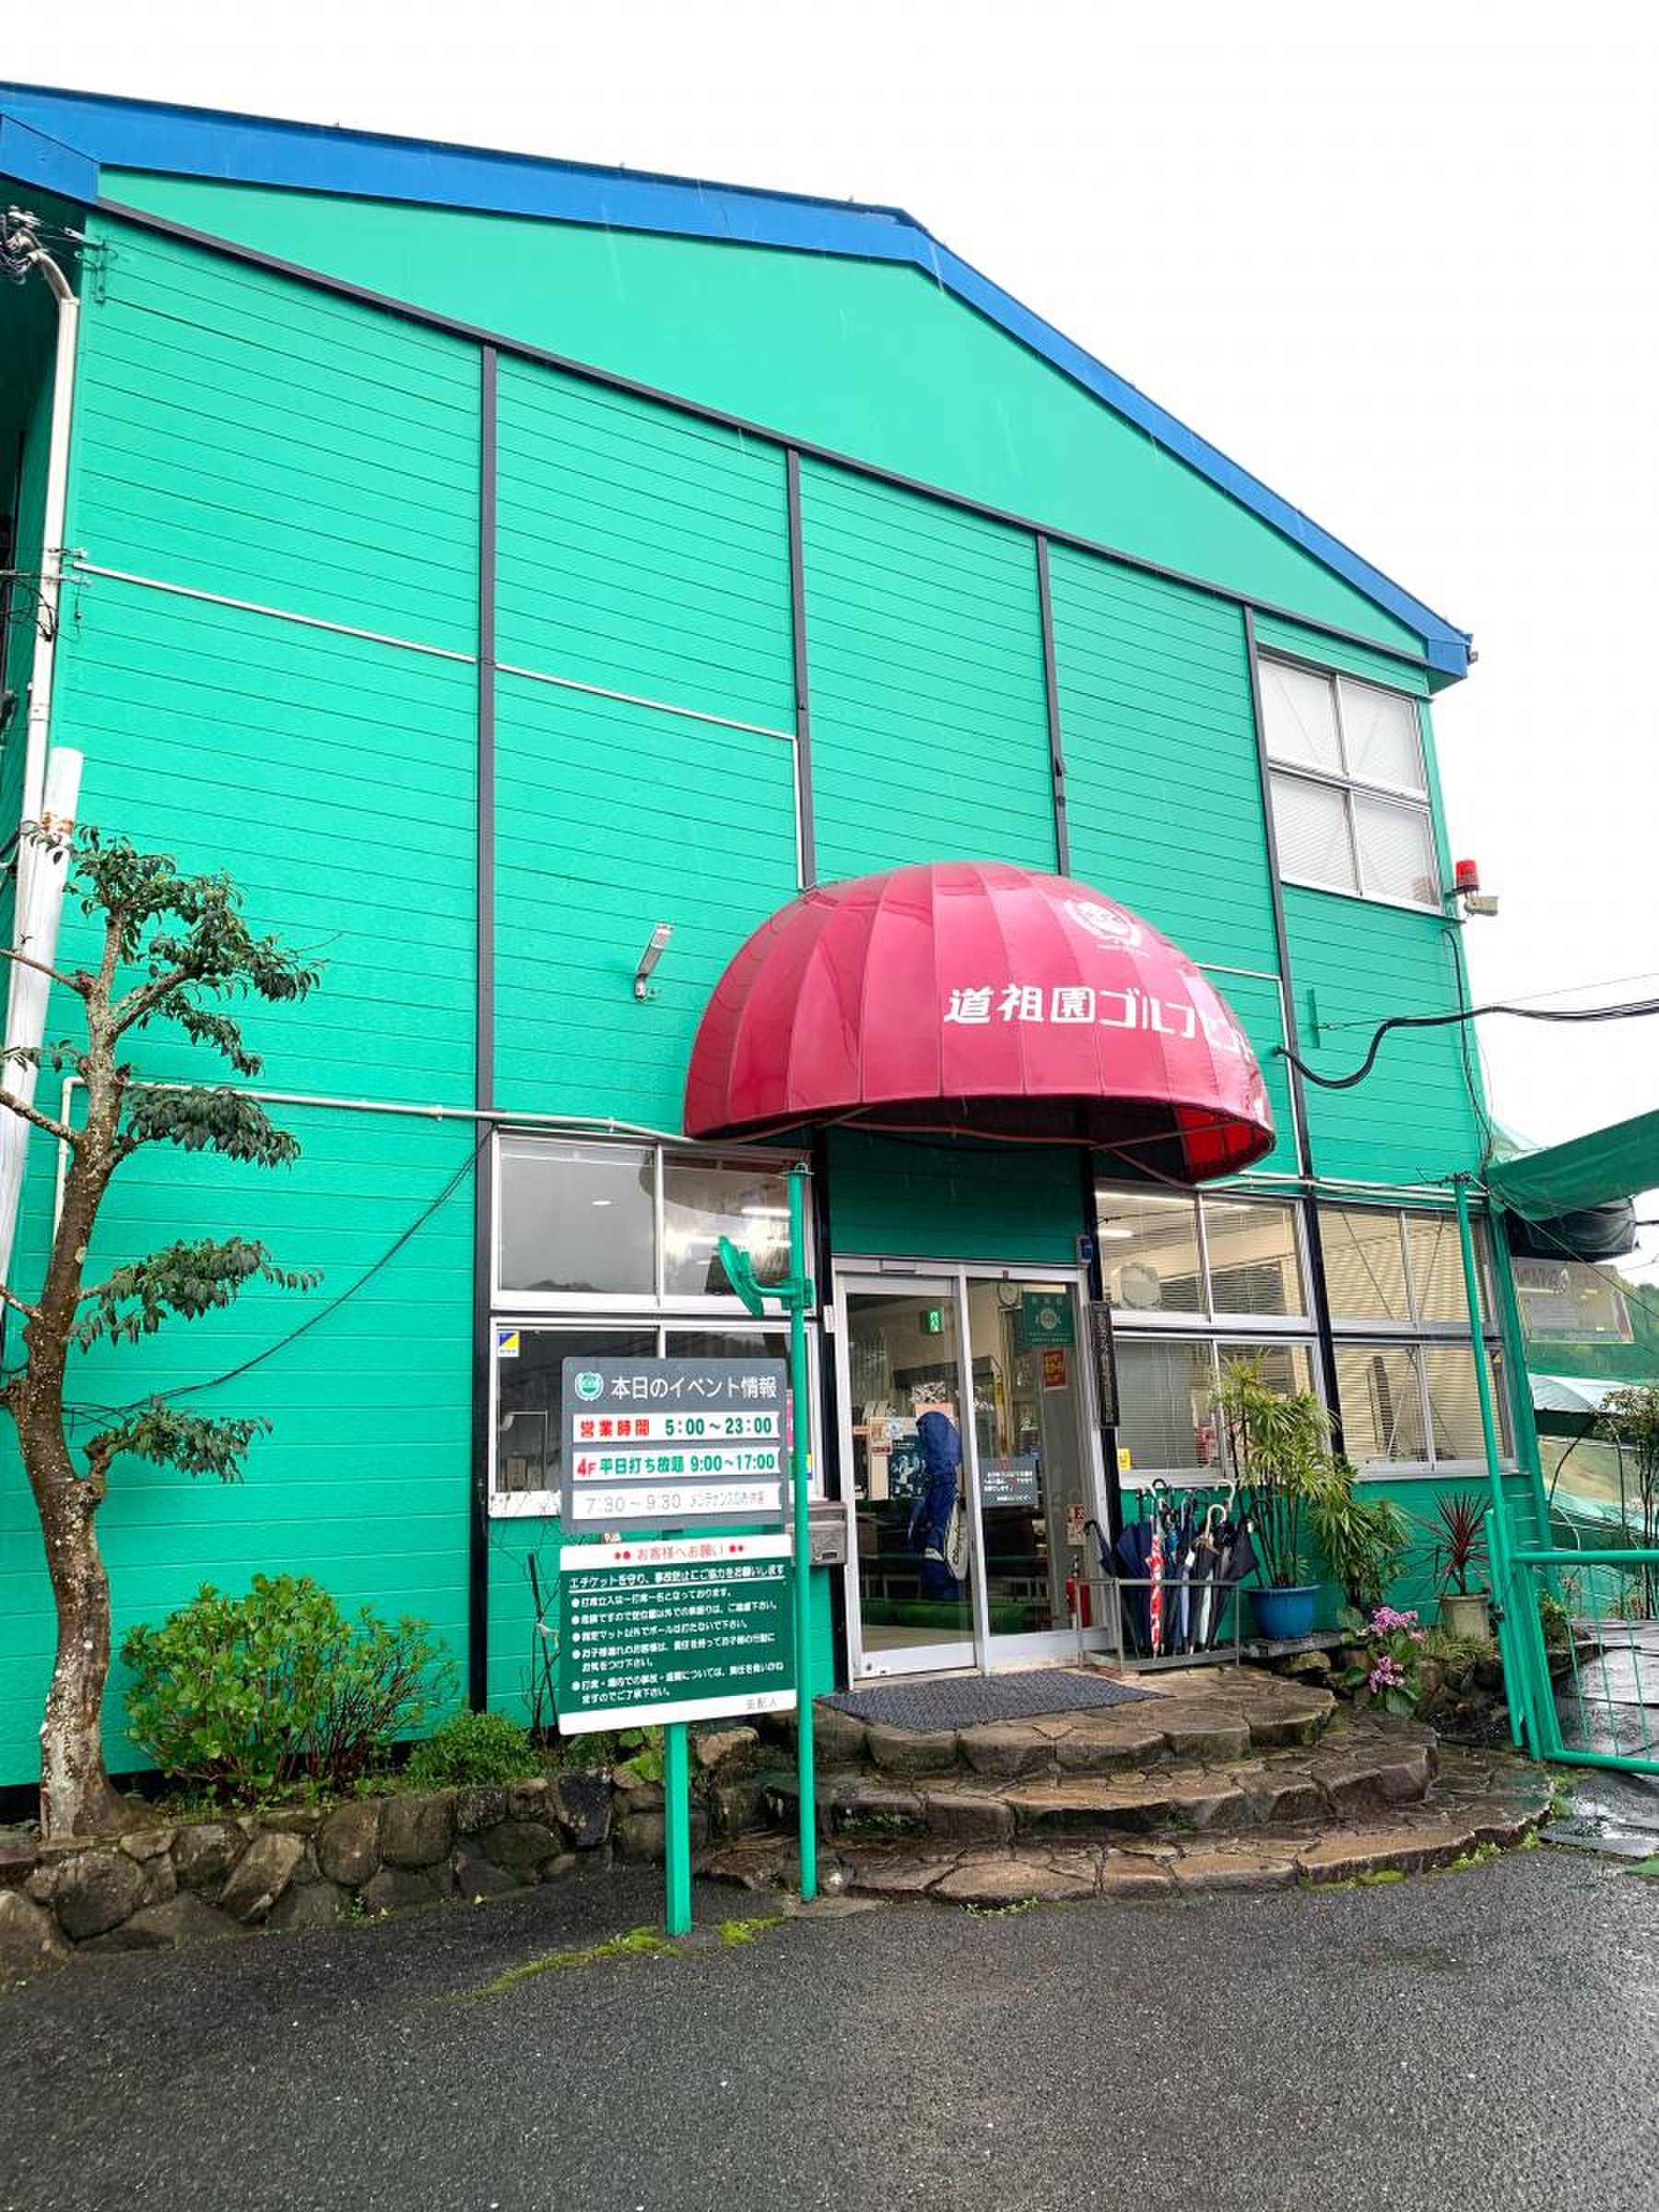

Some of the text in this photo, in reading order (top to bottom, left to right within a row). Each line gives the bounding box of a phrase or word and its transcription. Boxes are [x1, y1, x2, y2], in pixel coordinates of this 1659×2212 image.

[611, 1376, 777, 1401] 本日のイベント情報
[580, 1418, 650, 1438] 営業時間
[577, 1458, 596, 1477] 4F
[599, 1457, 685, 1475] 平日打ち放題
